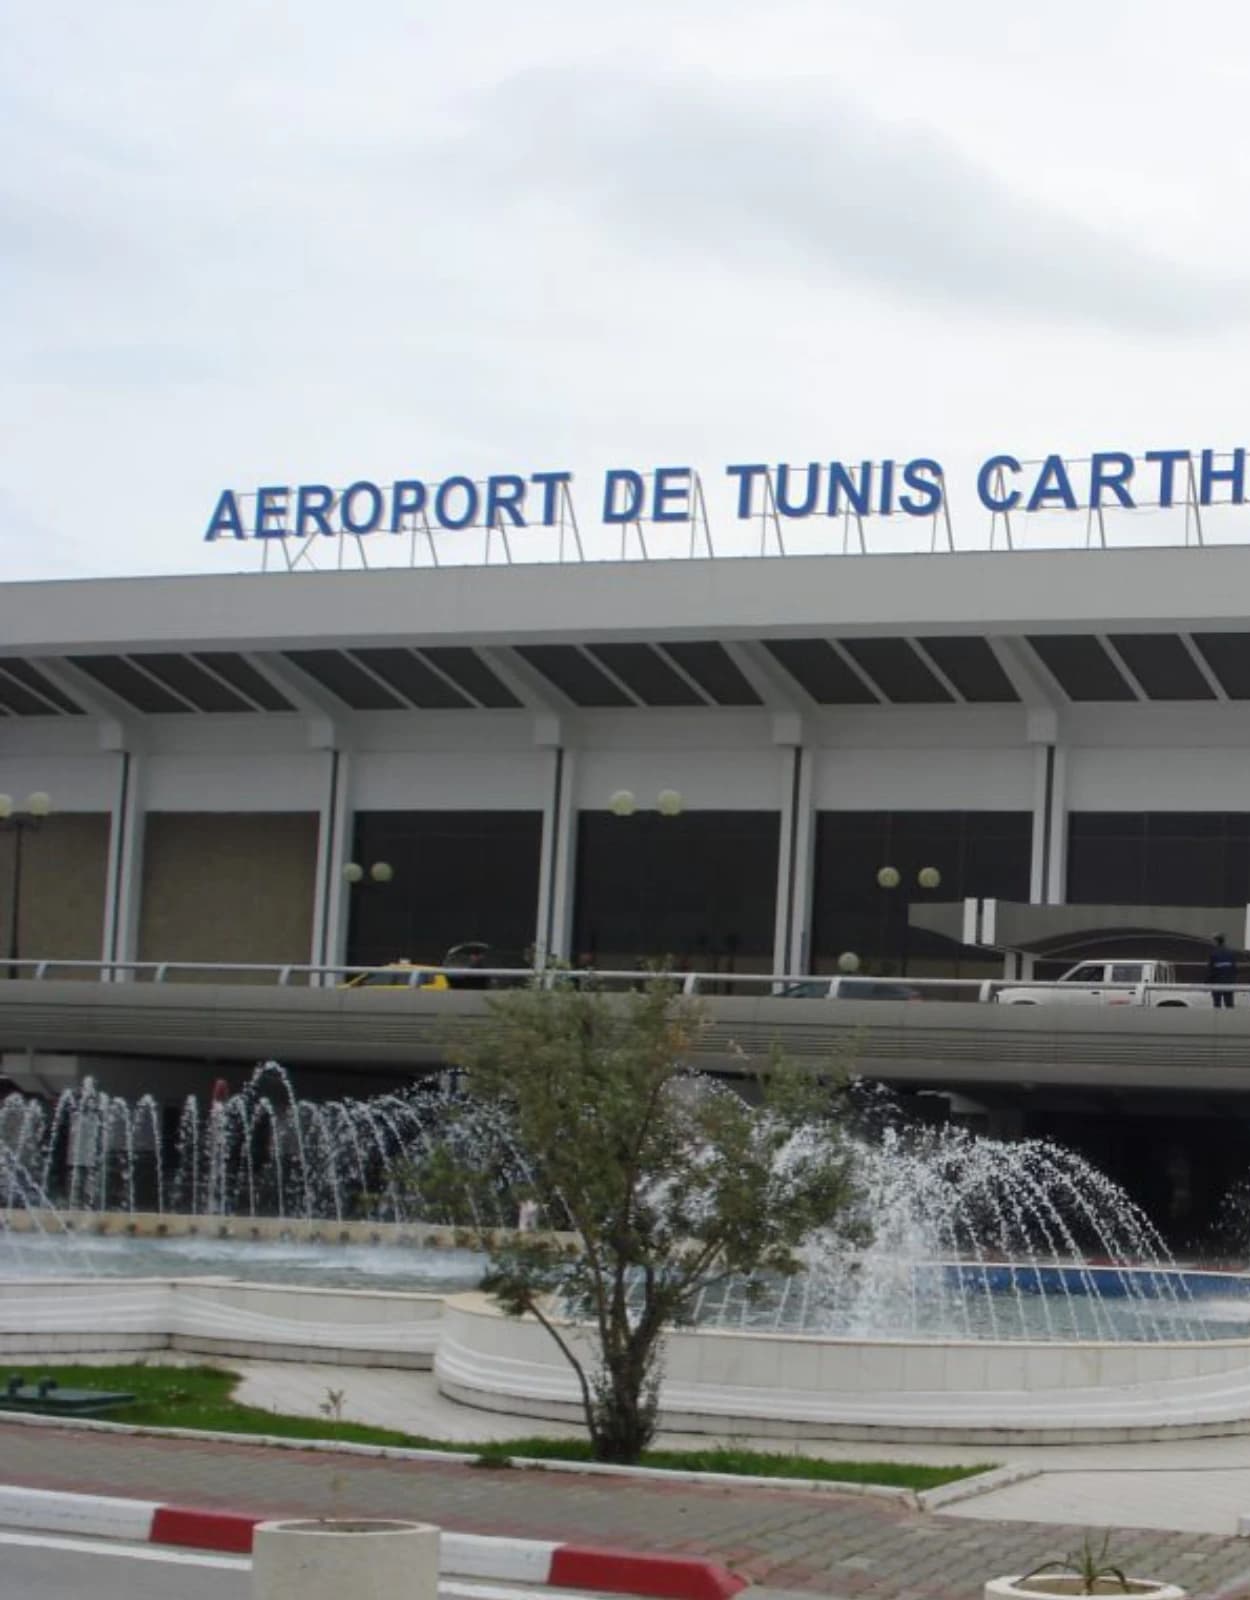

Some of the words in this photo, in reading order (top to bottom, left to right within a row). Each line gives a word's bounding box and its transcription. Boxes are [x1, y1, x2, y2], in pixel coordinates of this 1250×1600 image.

[204, 472, 573, 542] AEROPORT
[602, 467, 691, 524] DE
[726, 458, 943, 519] TUNIS
